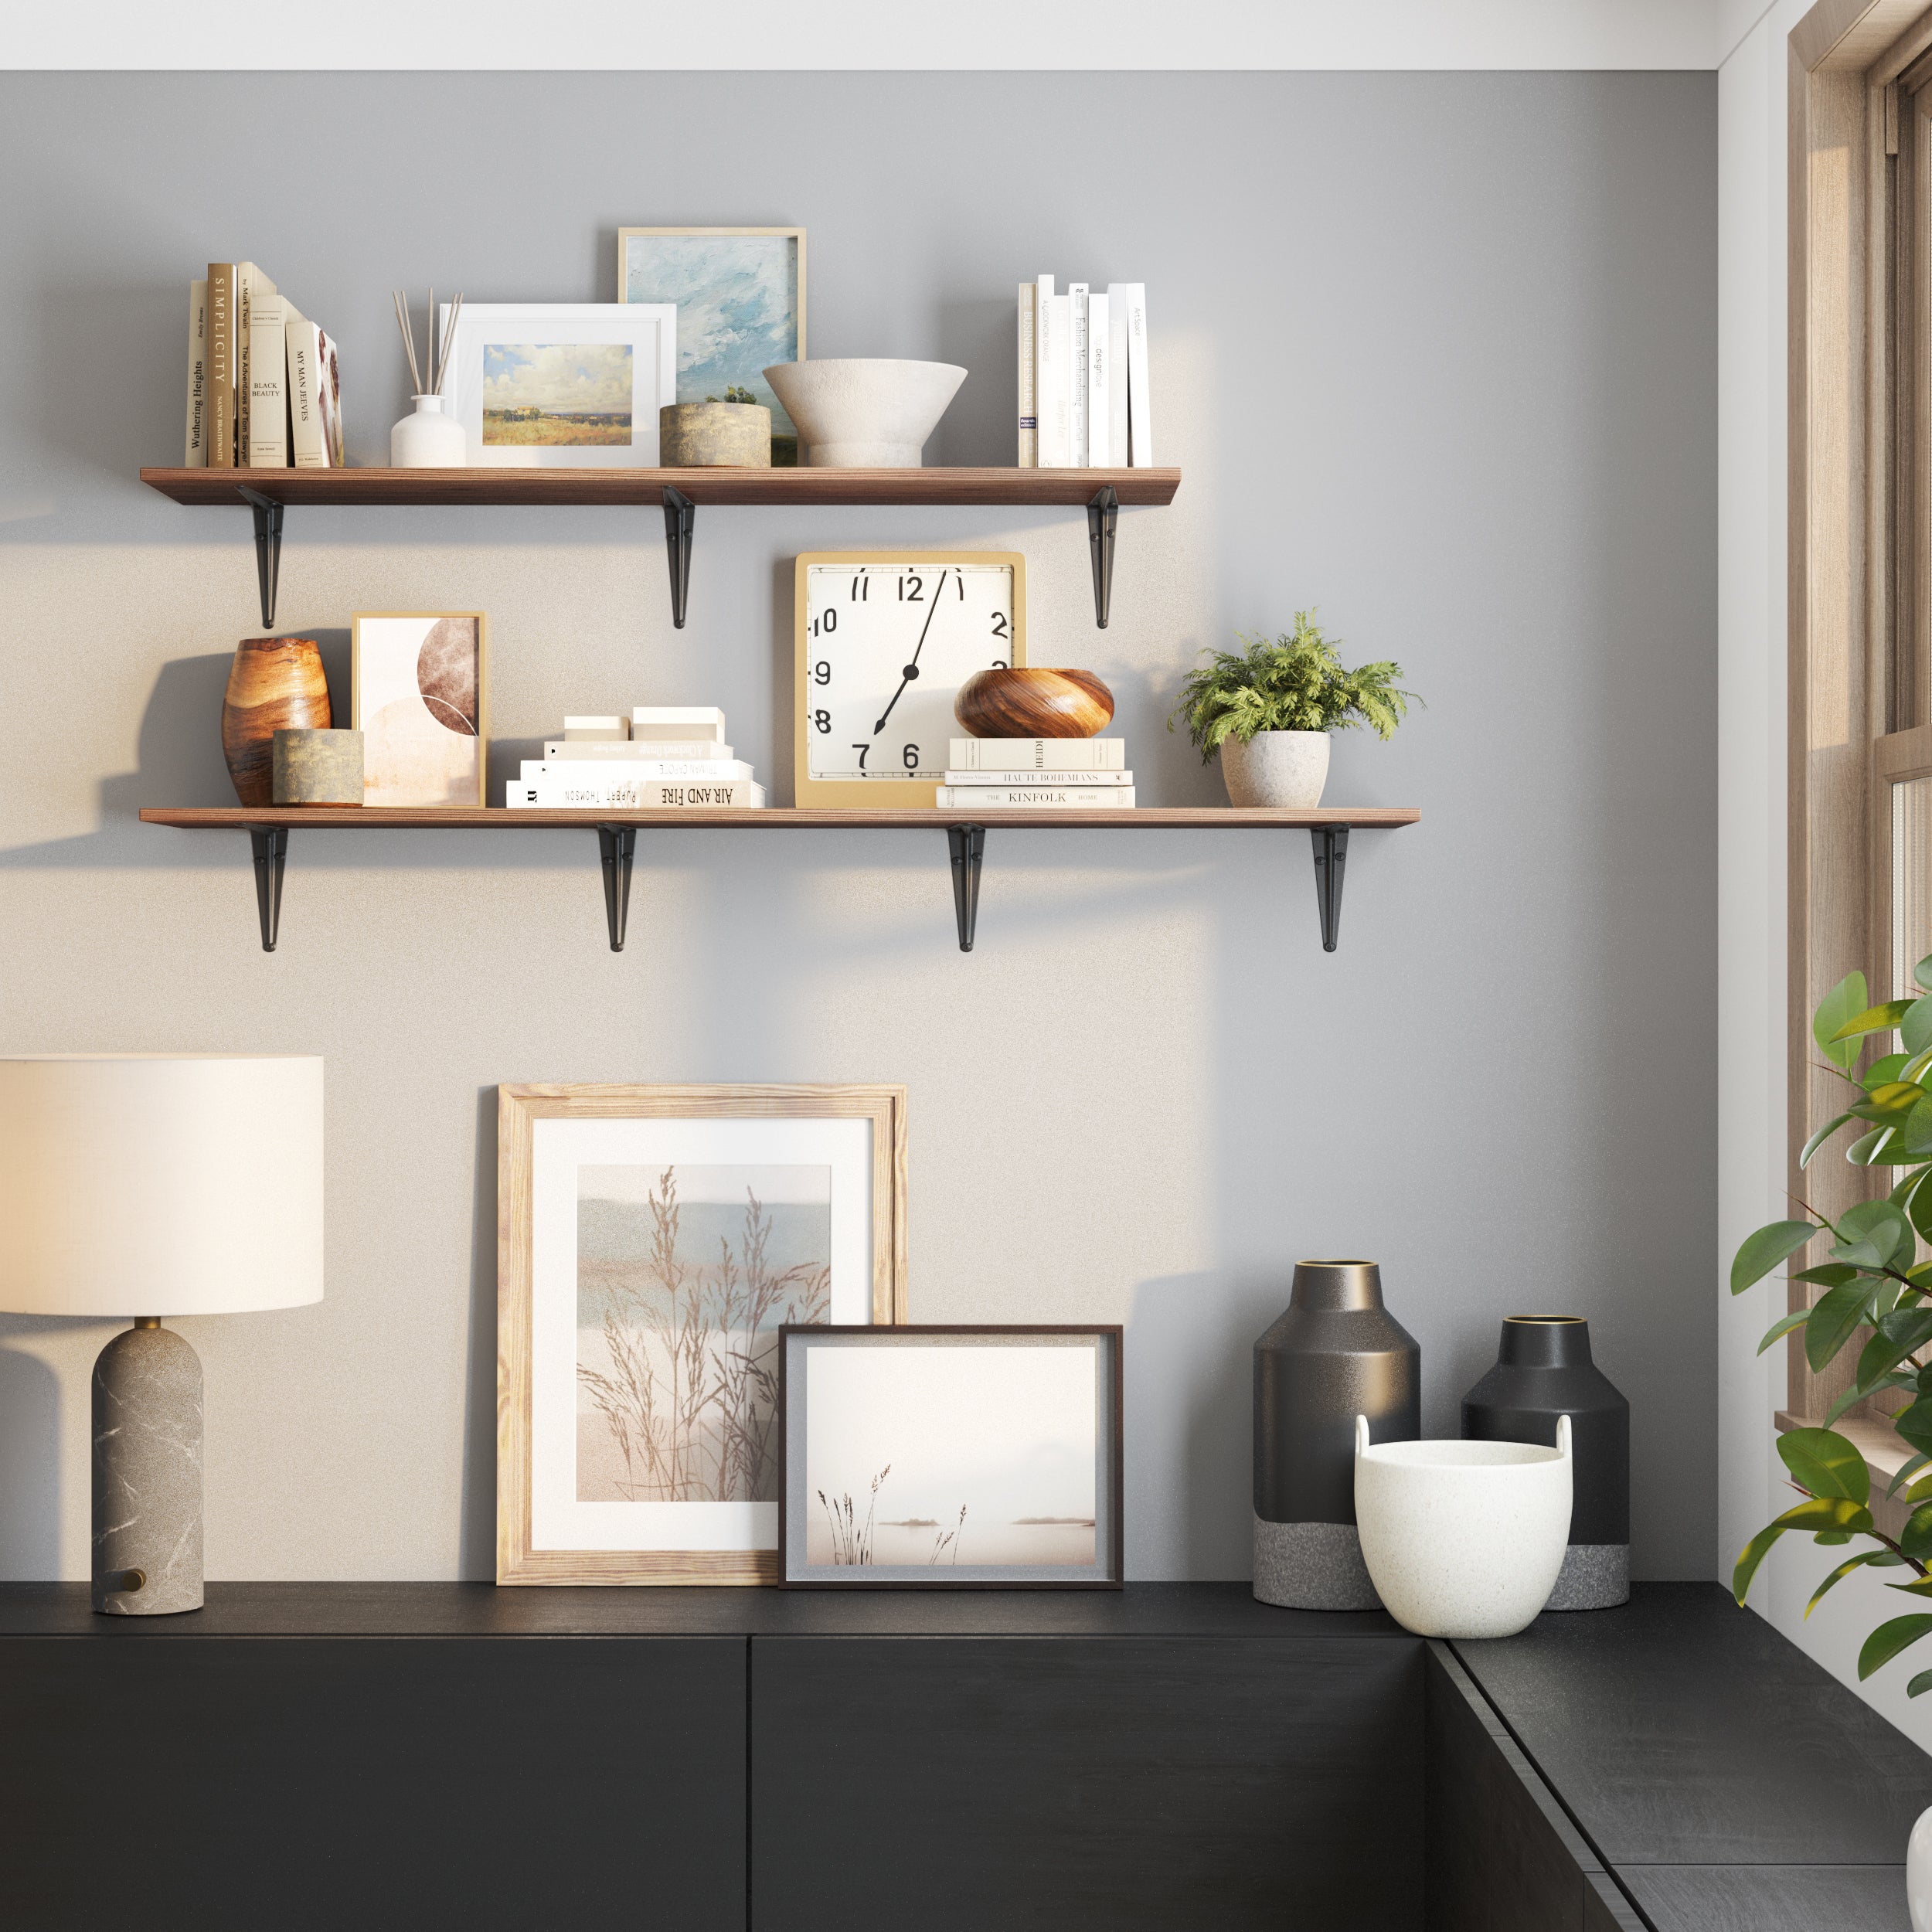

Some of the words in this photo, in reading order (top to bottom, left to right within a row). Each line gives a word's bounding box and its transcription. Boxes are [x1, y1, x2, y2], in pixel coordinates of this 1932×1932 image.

[215, 277, 225, 383] SIMPLICITY
[1023, 311, 1032, 359] BUSINESS
[1076, 317, 1085, 347] Fashion
[297, 351, 304, 365] MY
[192, 360, 204, 397] Heights
[1023, 361, 1033, 415] RESEARCH
[1073, 349, 1086, 407] Merchandising
[242, 406, 248, 416] of
[300, 389, 309, 421] JEEVES
[192, 397, 203, 449] Wuthering
[852, 576, 868, 601] 11
[898, 576, 923, 601] 12
[955, 576, 964, 601] 1
[815, 607, 836, 637] 10
[991, 611, 1008, 639] 2
[815, 661, 831, 685] 9
[815, 709, 832, 734] 8
[852, 744, 870, 769] 7
[903, 743, 920, 769] 6
[659, 764, 688, 774] CAPOTE
[689, 764, 718, 774] TRUMAN
[1004, 774, 1036, 782] HAUTE
[1040, 774, 1099, 782] BOHEMIANS
[565, 791, 600, 803] THOMSON
[606, 791, 636, 803] RUPERT
[662, 788, 684, 806] FIRE
[687, 788, 713, 804] AND
[715, 788, 733, 805] AIR
[1009, 793, 1066, 802] KINFOLK
